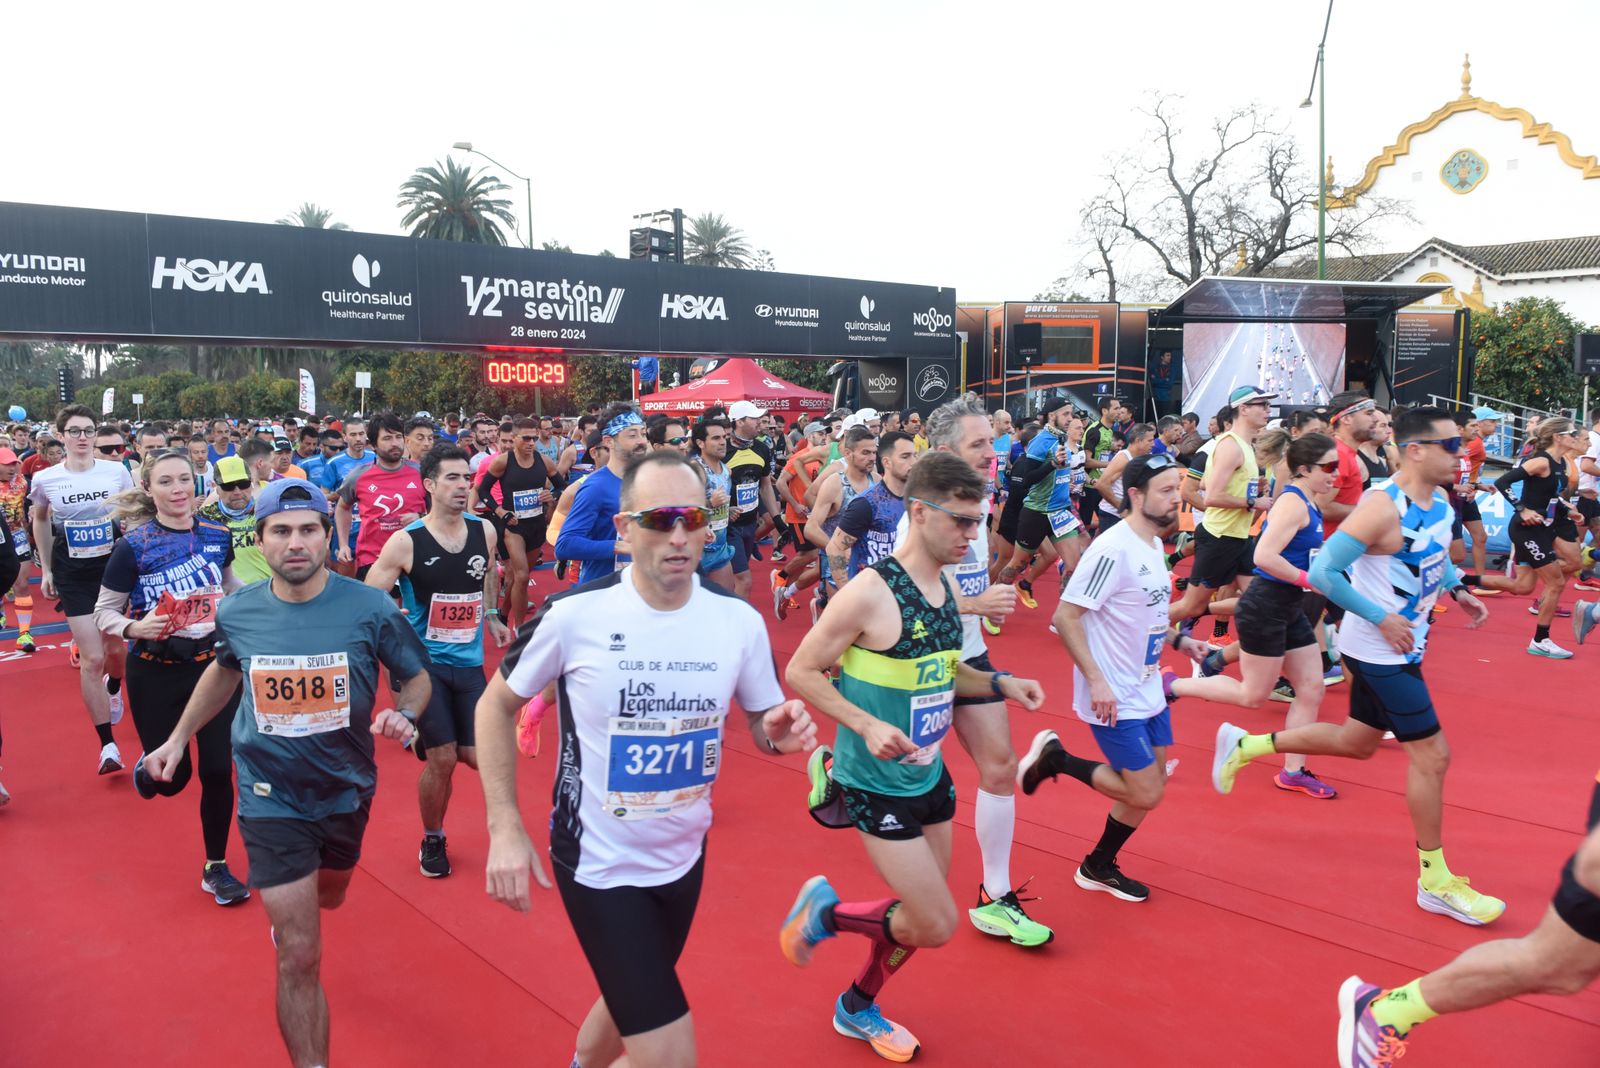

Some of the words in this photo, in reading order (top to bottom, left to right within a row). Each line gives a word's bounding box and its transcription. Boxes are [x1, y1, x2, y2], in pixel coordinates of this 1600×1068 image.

[0, 253, 86, 273] YUNDAI
[0, 273, 49, 285] undauto
[50, 275, 86, 287] Motor
[151, 256, 270, 295] HOKA
[493, 276, 603, 303] maratón
[321, 288, 413, 307] quirónsalud
[660, 293, 727, 321] HOKA
[774, 306, 820, 320] HYUNDAI
[329, 308, 375, 321] Healthcare
[375, 310, 406, 322] Partner
[803, 320, 819, 328] Motor
[843, 320, 892, 333] quirónsalud
[510, 325, 525, 338] 28
[526, 328, 559, 339] enero
[560, 328, 587, 340] 2024
[847, 334, 872, 342] Healthcare
[871, 335, 889, 343] Partner
[488, 362, 565, 384] 00:00:29
[62, 490, 109, 505] LEPAPE
[72, 527, 104, 542] 2019
[866, 529, 889, 543] MEDIO
[138, 571, 165, 586] MEDIO
[960, 574, 986, 597] 2951
[440, 605, 475, 621] 1329
[306, 655, 335, 668] SEVILLA
[618, 660, 645, 671] CLUB
[648, 661, 662, 671] DE
[666, 661, 718, 672] ATLETISMO
[265, 675, 326, 701] 3618
[618, 688, 717, 718] Legendarios
[679, 717, 711, 732] SEVILLA
[624, 740, 695, 775] 3271
